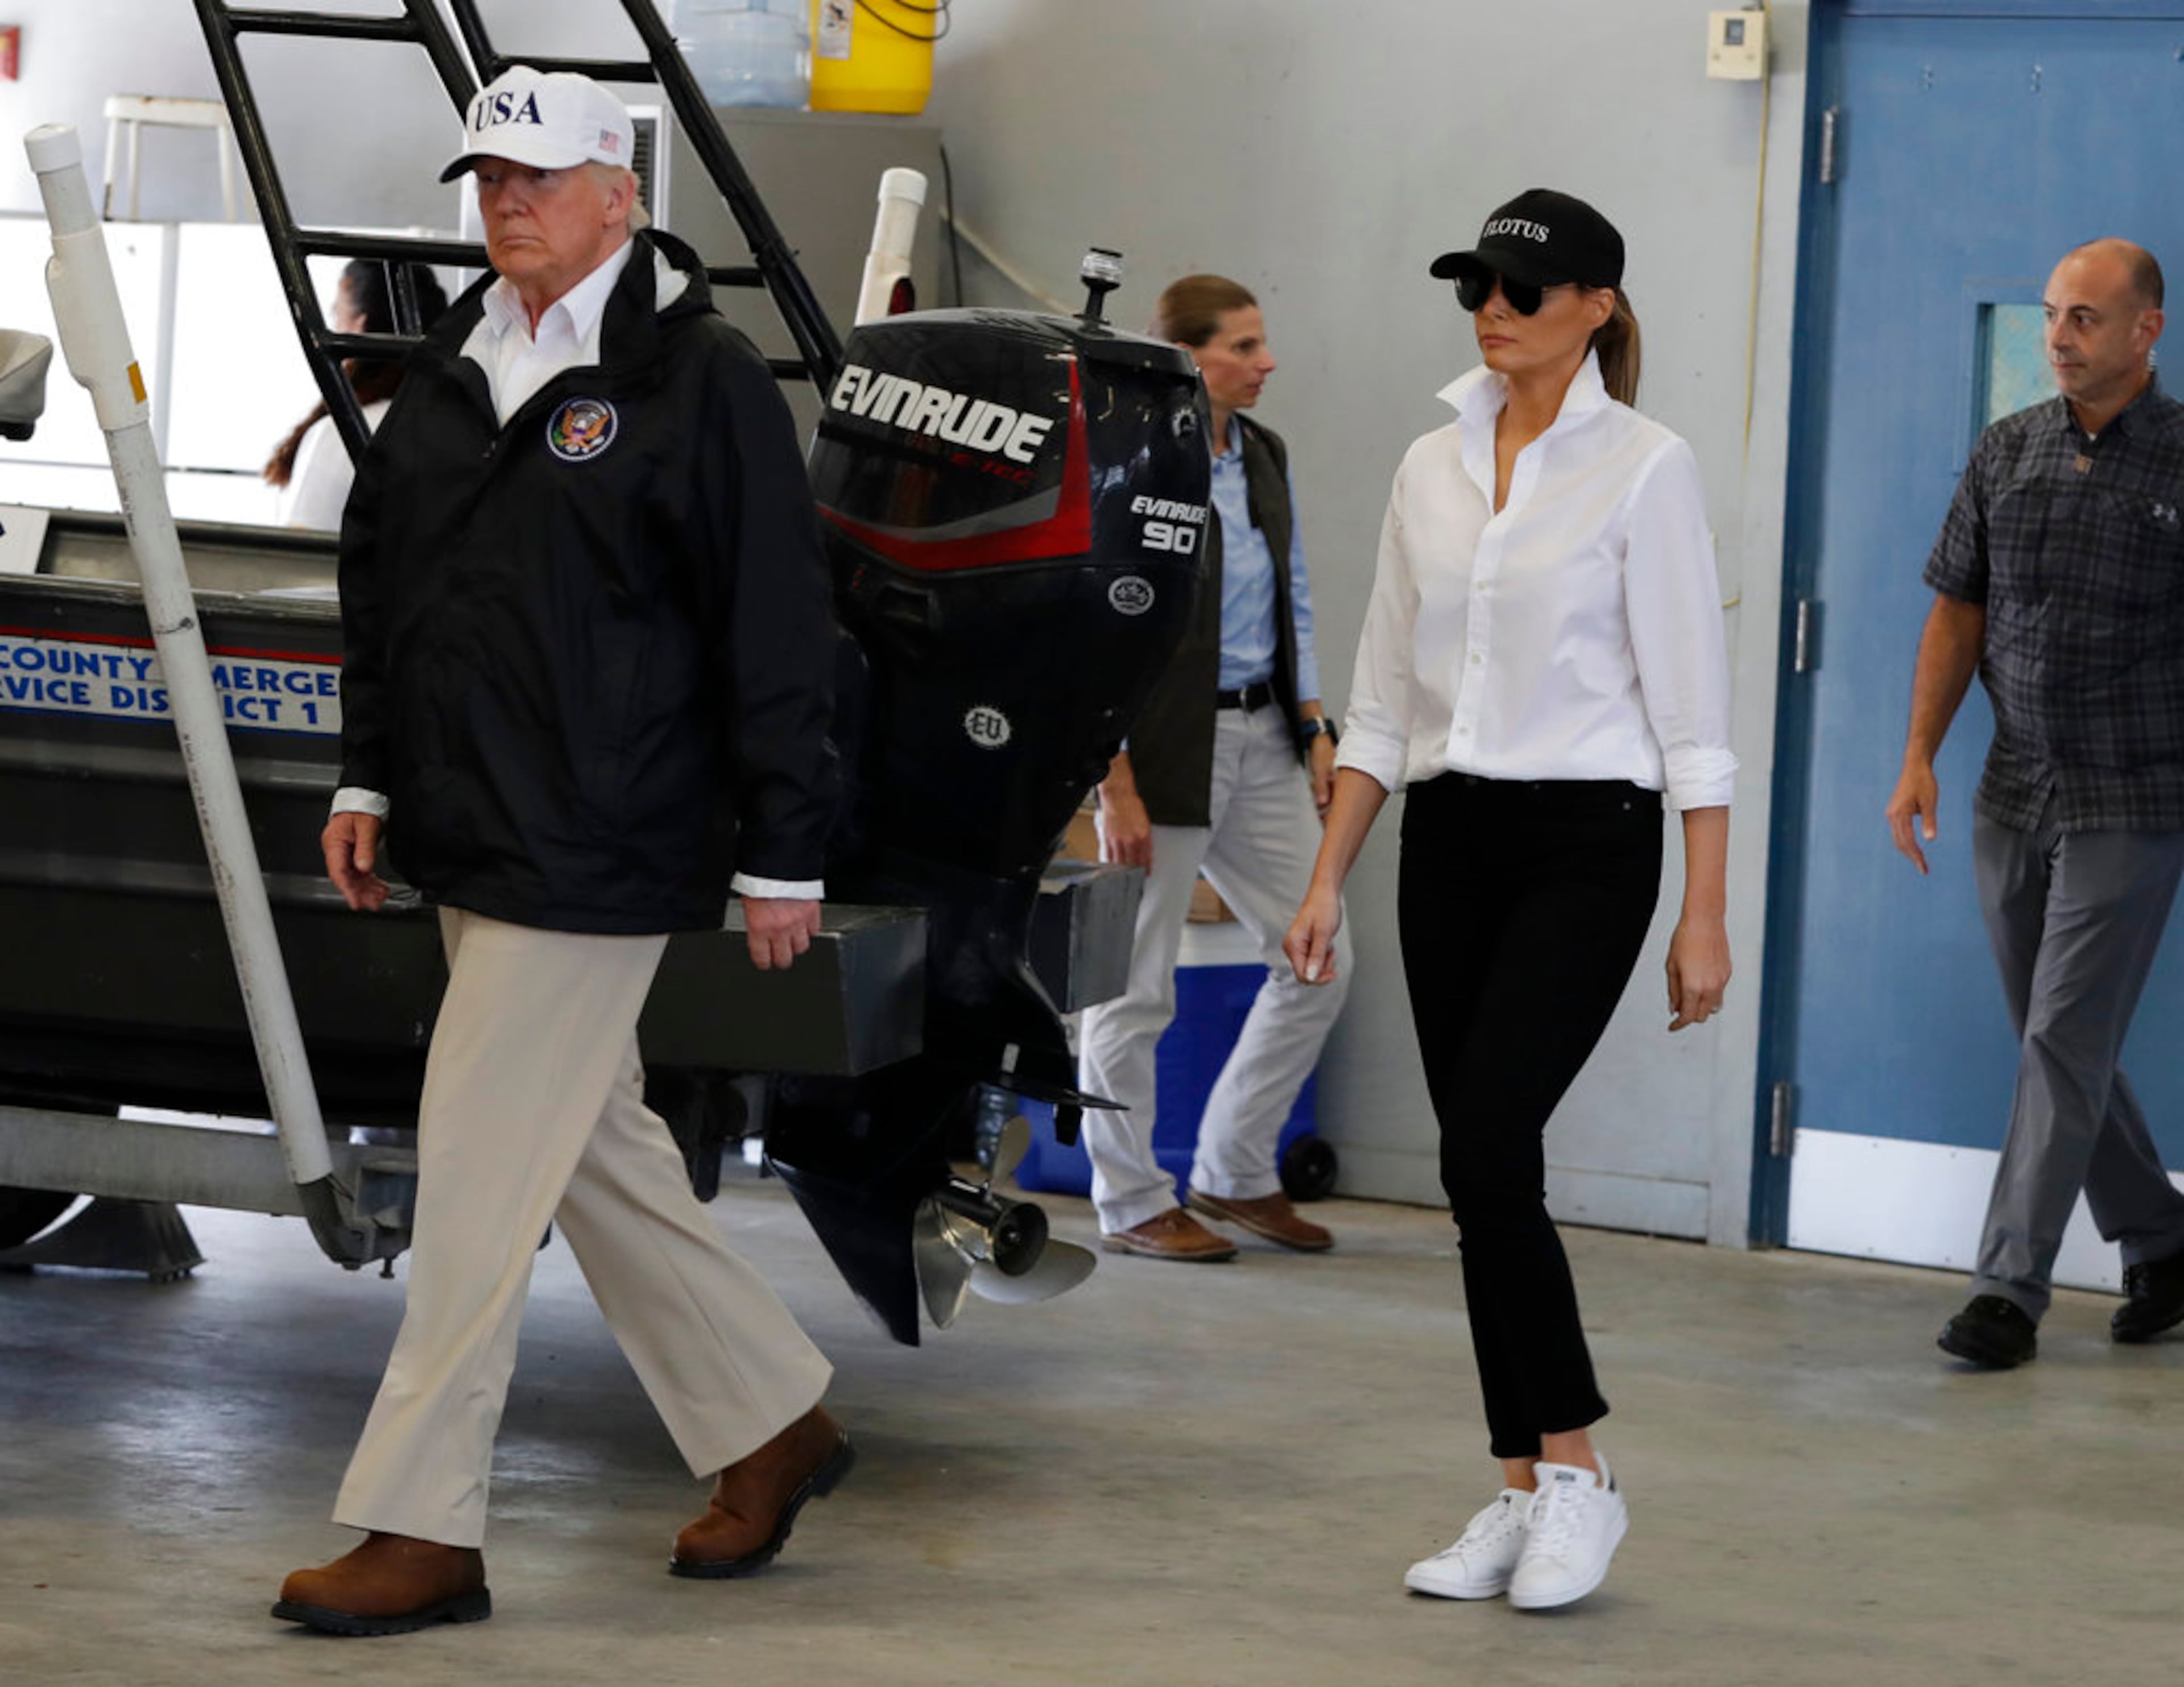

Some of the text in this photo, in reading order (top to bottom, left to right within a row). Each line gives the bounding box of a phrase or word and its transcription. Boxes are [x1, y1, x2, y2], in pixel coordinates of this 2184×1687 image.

[475, 90, 543, 133] USA
[830, 364, 1054, 464] EVINRUDE
[1130, 495, 1207, 524] EVINRUDE
[1141, 520, 1196, 555] 90
[213, 664, 338, 696] MERGE
[0, 676, 318, 725] VICE DISICT 1
